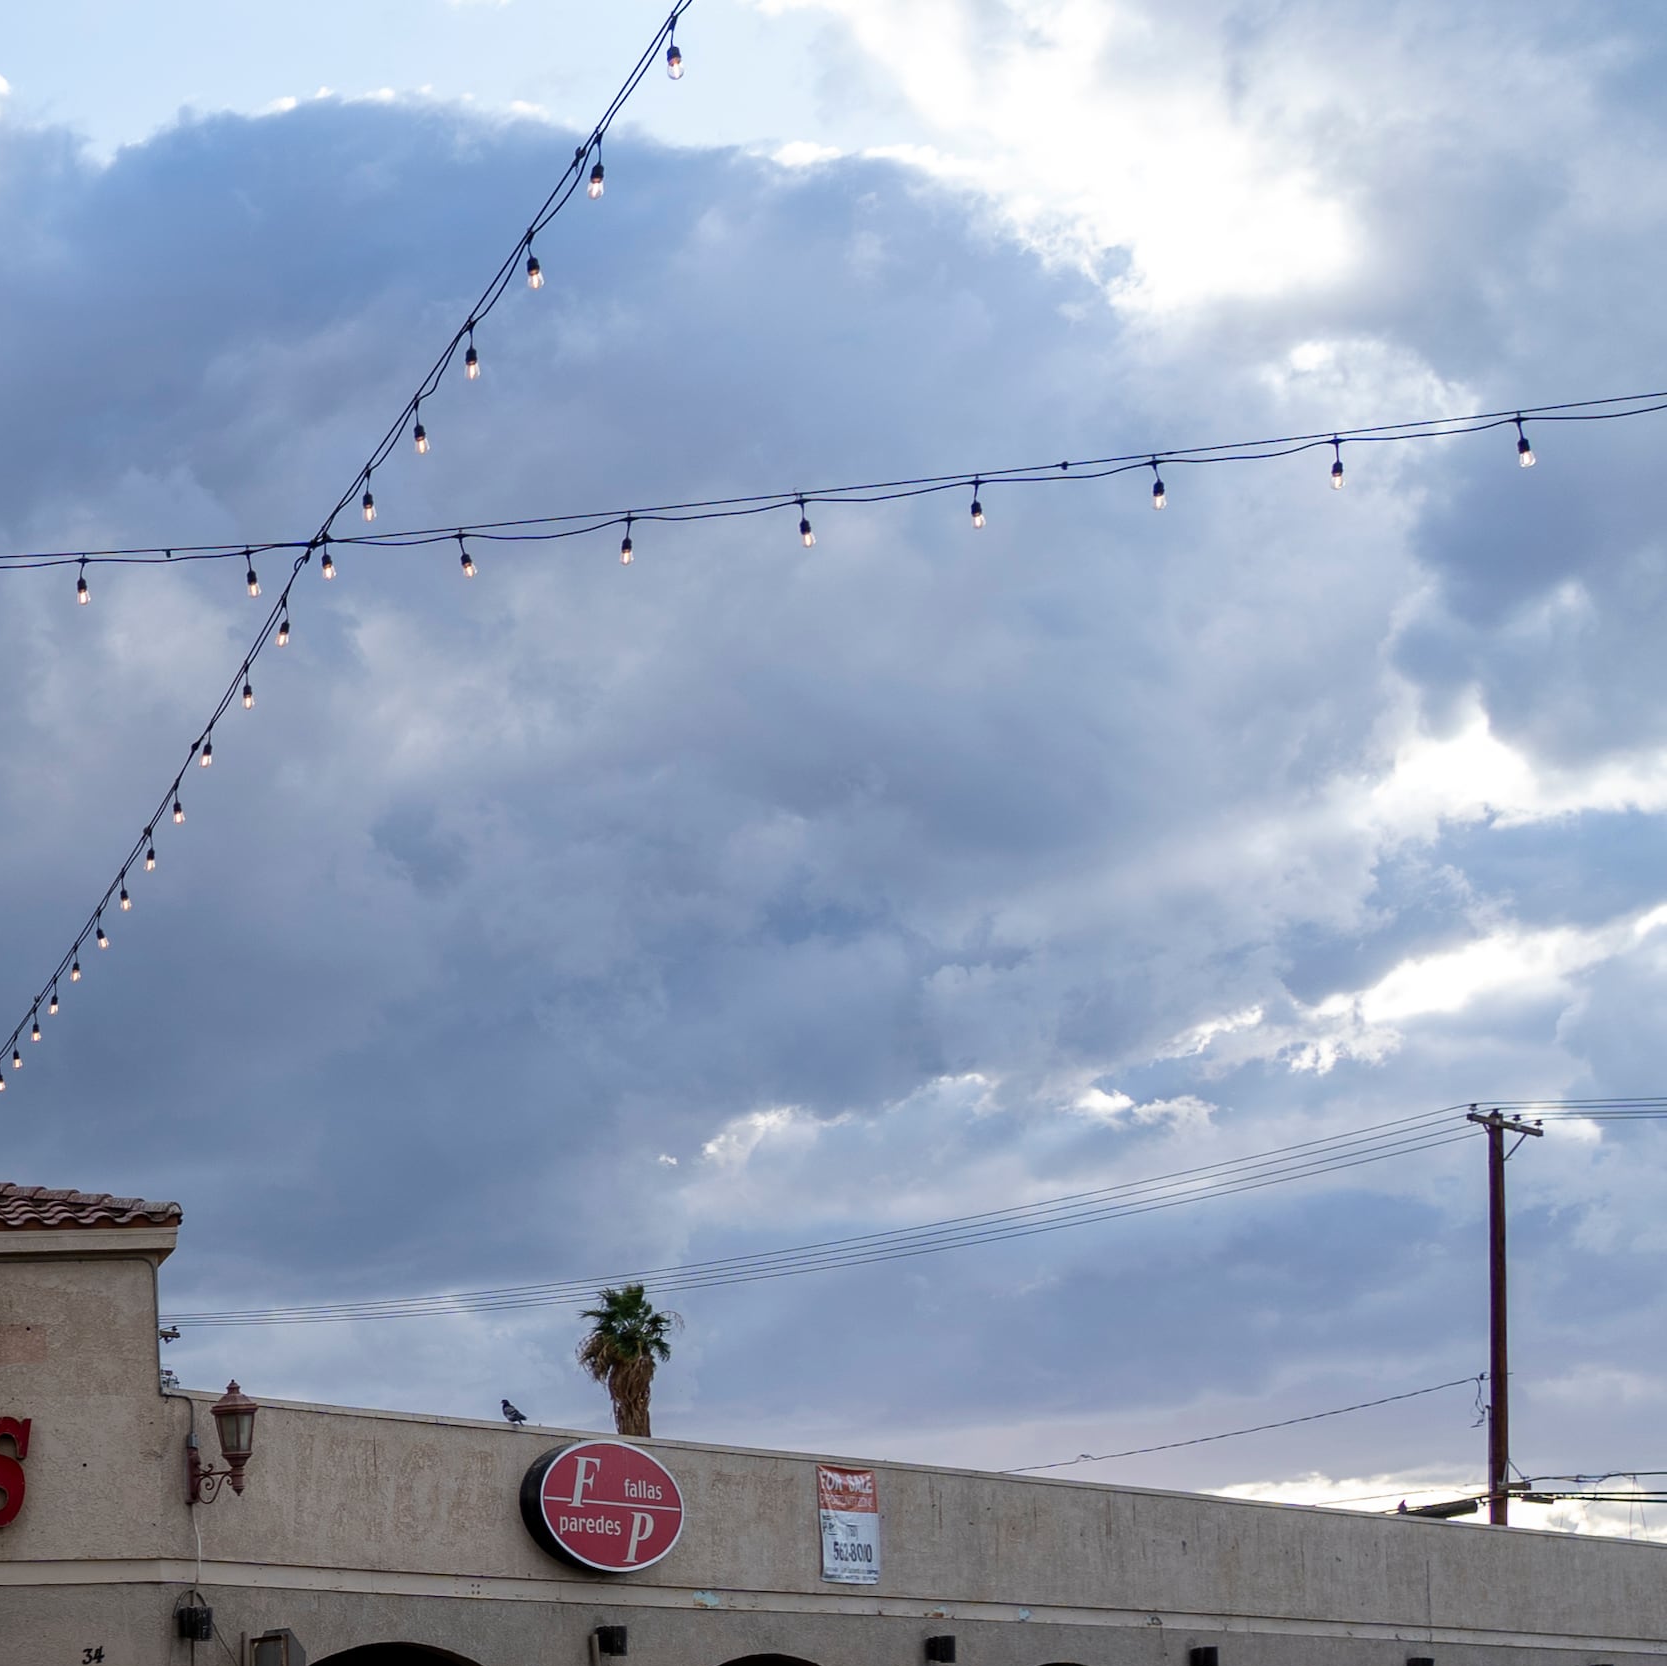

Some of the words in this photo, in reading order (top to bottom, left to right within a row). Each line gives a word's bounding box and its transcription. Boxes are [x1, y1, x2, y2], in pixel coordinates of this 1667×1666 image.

[567, 1456, 601, 1508] F
[624, 1479, 663, 1500] fallas
[819, 1471, 843, 1491] FOR
[846, 1474, 873, 1494] SALE
[559, 1515, 622, 1536] paredes
[622, 1511, 655, 1563] P
[82, 1645, 105, 1665] 34
